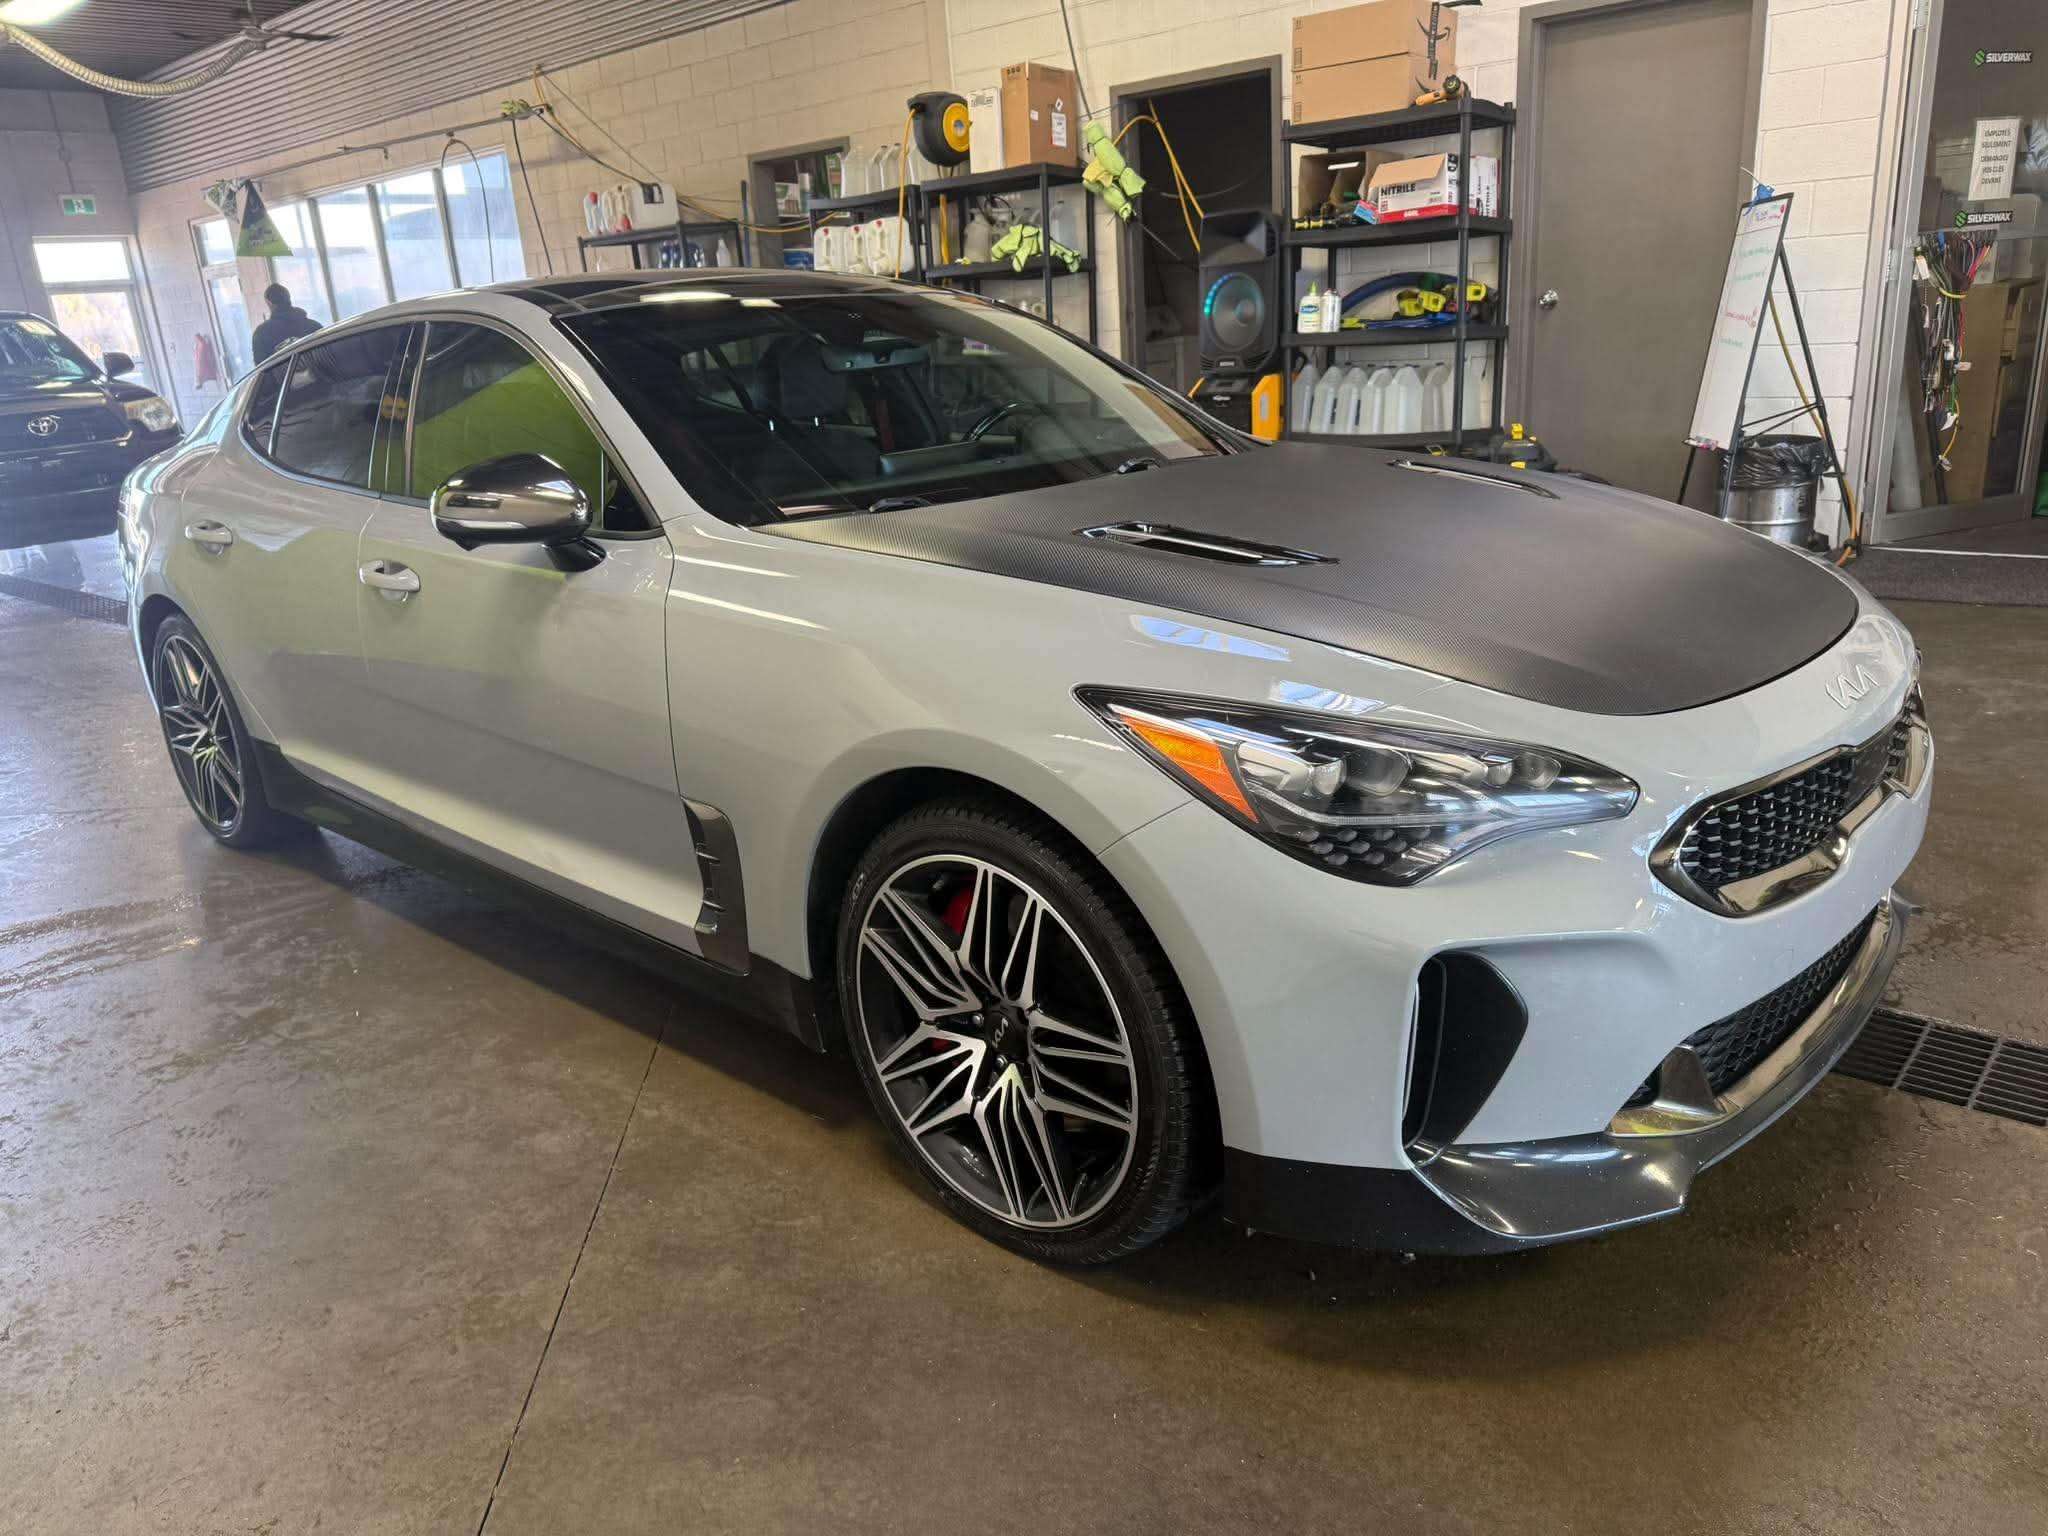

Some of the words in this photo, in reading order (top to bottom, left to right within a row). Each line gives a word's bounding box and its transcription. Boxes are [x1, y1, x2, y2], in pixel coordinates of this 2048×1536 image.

[1986, 52, 2033, 63] SILVERWAX
[1380, 183, 1416, 196] NITRILE
[1967, 212, 2012, 224] SILVERWAX
[1825, 664, 1880, 711] KIA
